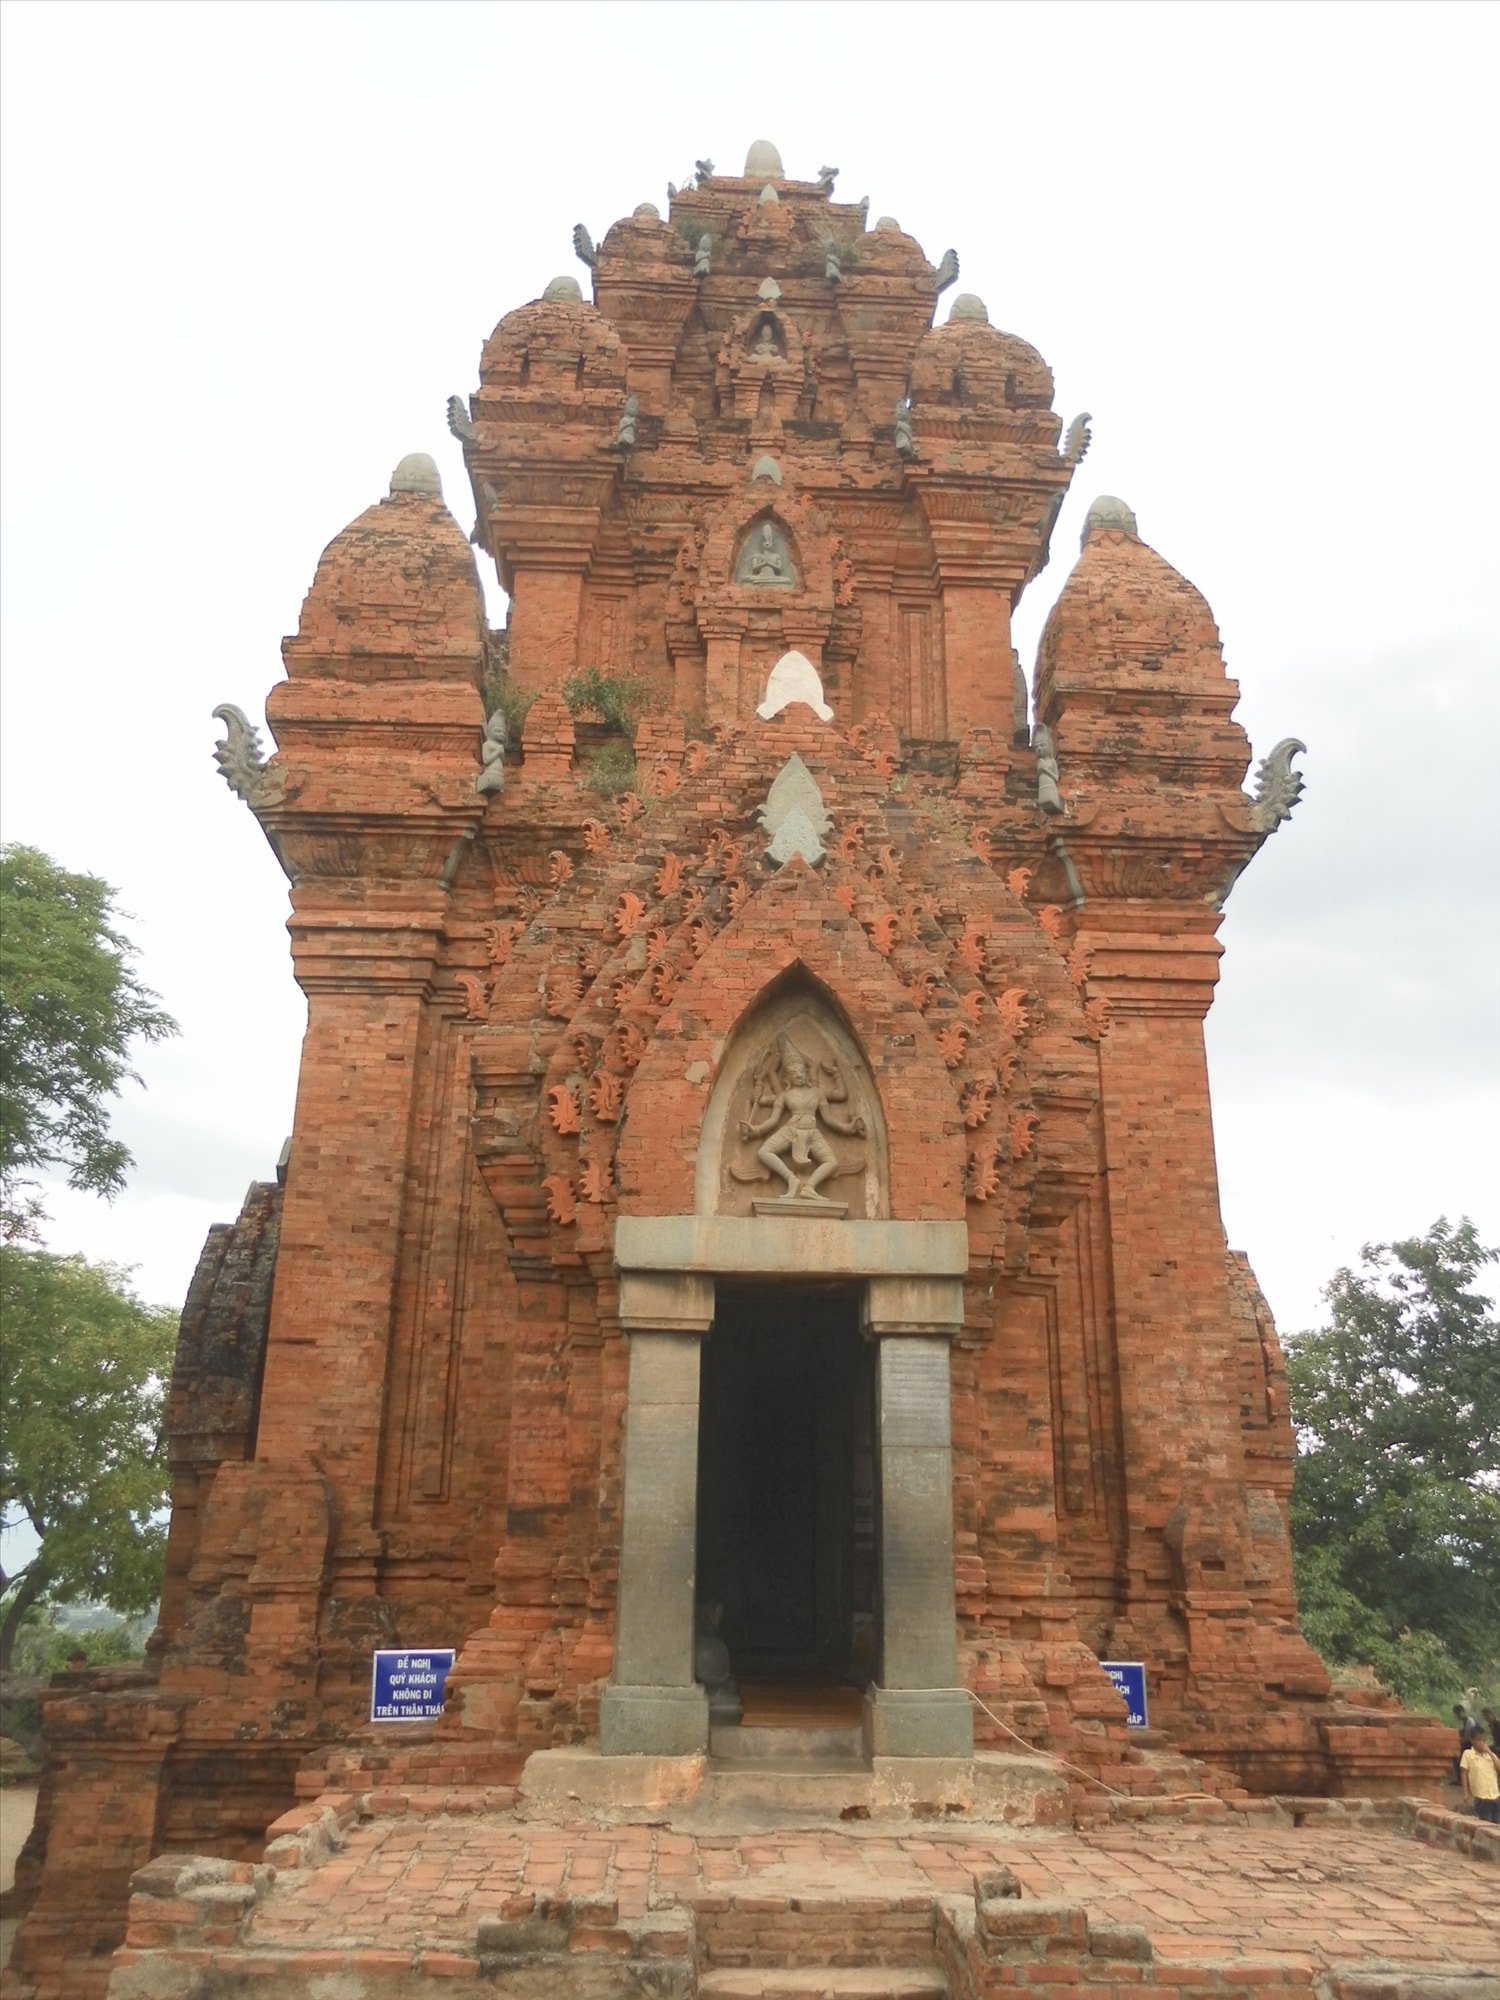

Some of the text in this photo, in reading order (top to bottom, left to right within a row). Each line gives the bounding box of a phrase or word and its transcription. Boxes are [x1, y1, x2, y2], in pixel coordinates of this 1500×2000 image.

[411, 1658, 431, 1670] NGHỊ
[389, 1672, 437, 1686] QUÝ KHÁCH
[392, 1687, 421, 1700] KHÔNG
[376, 1703, 399, 1716] TRÊN
[400, 1702, 423, 1715] THÂN
